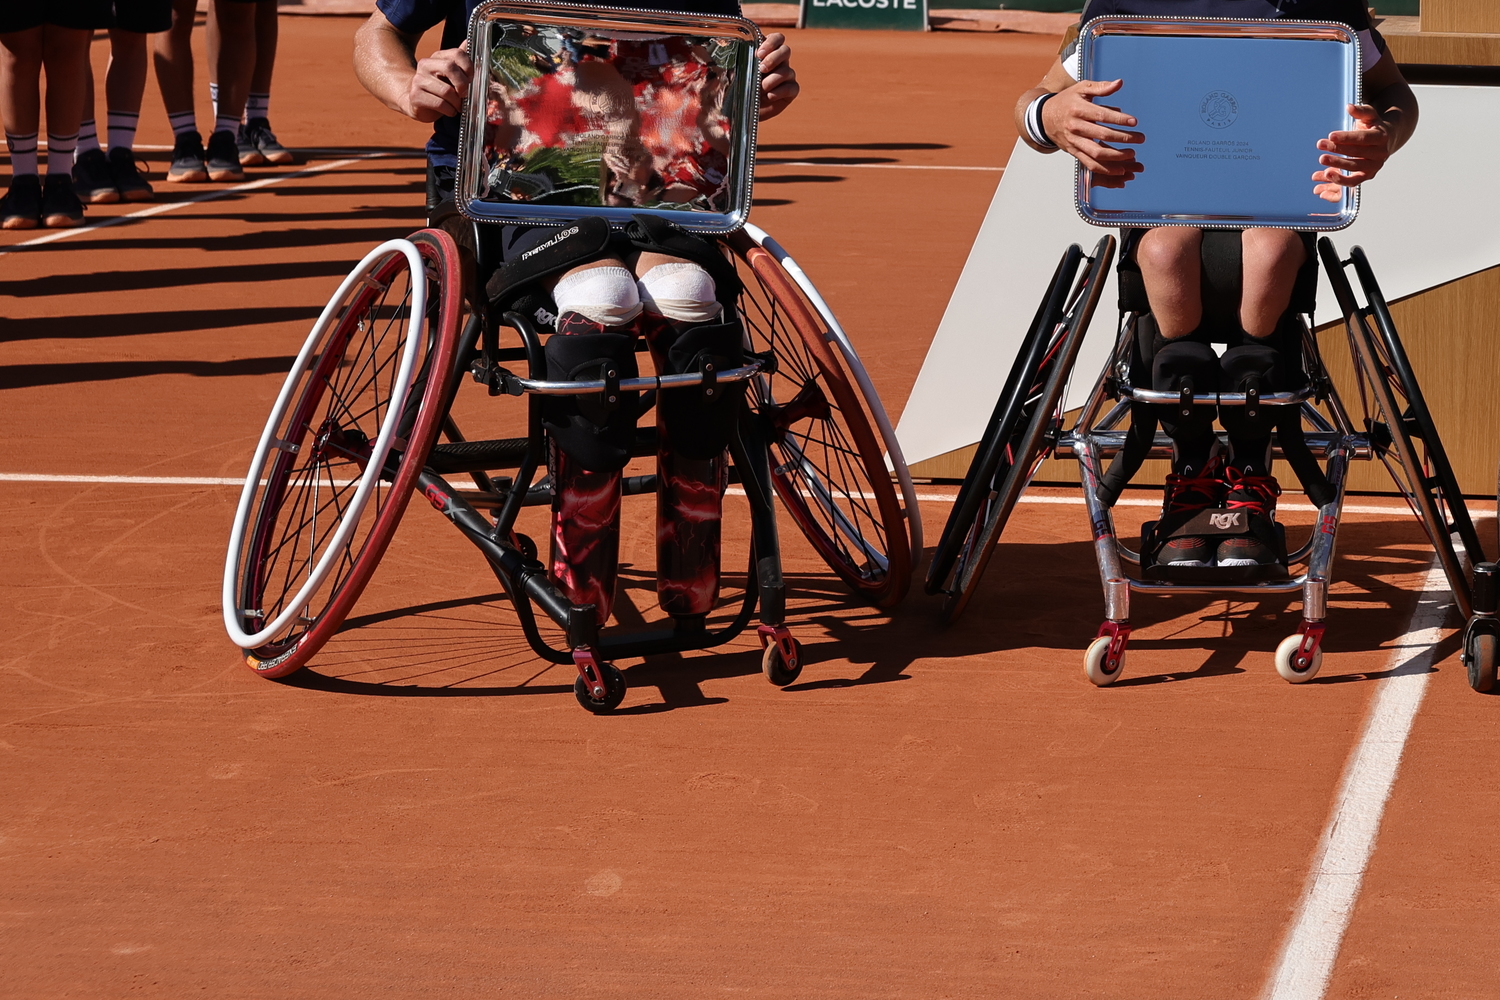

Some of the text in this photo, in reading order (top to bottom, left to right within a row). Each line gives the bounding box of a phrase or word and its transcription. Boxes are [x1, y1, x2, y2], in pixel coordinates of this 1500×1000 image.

[425, 483, 467, 519] GSX
[1209, 512, 1241, 530] RGK
[1321, 514, 1337, 537] GS
